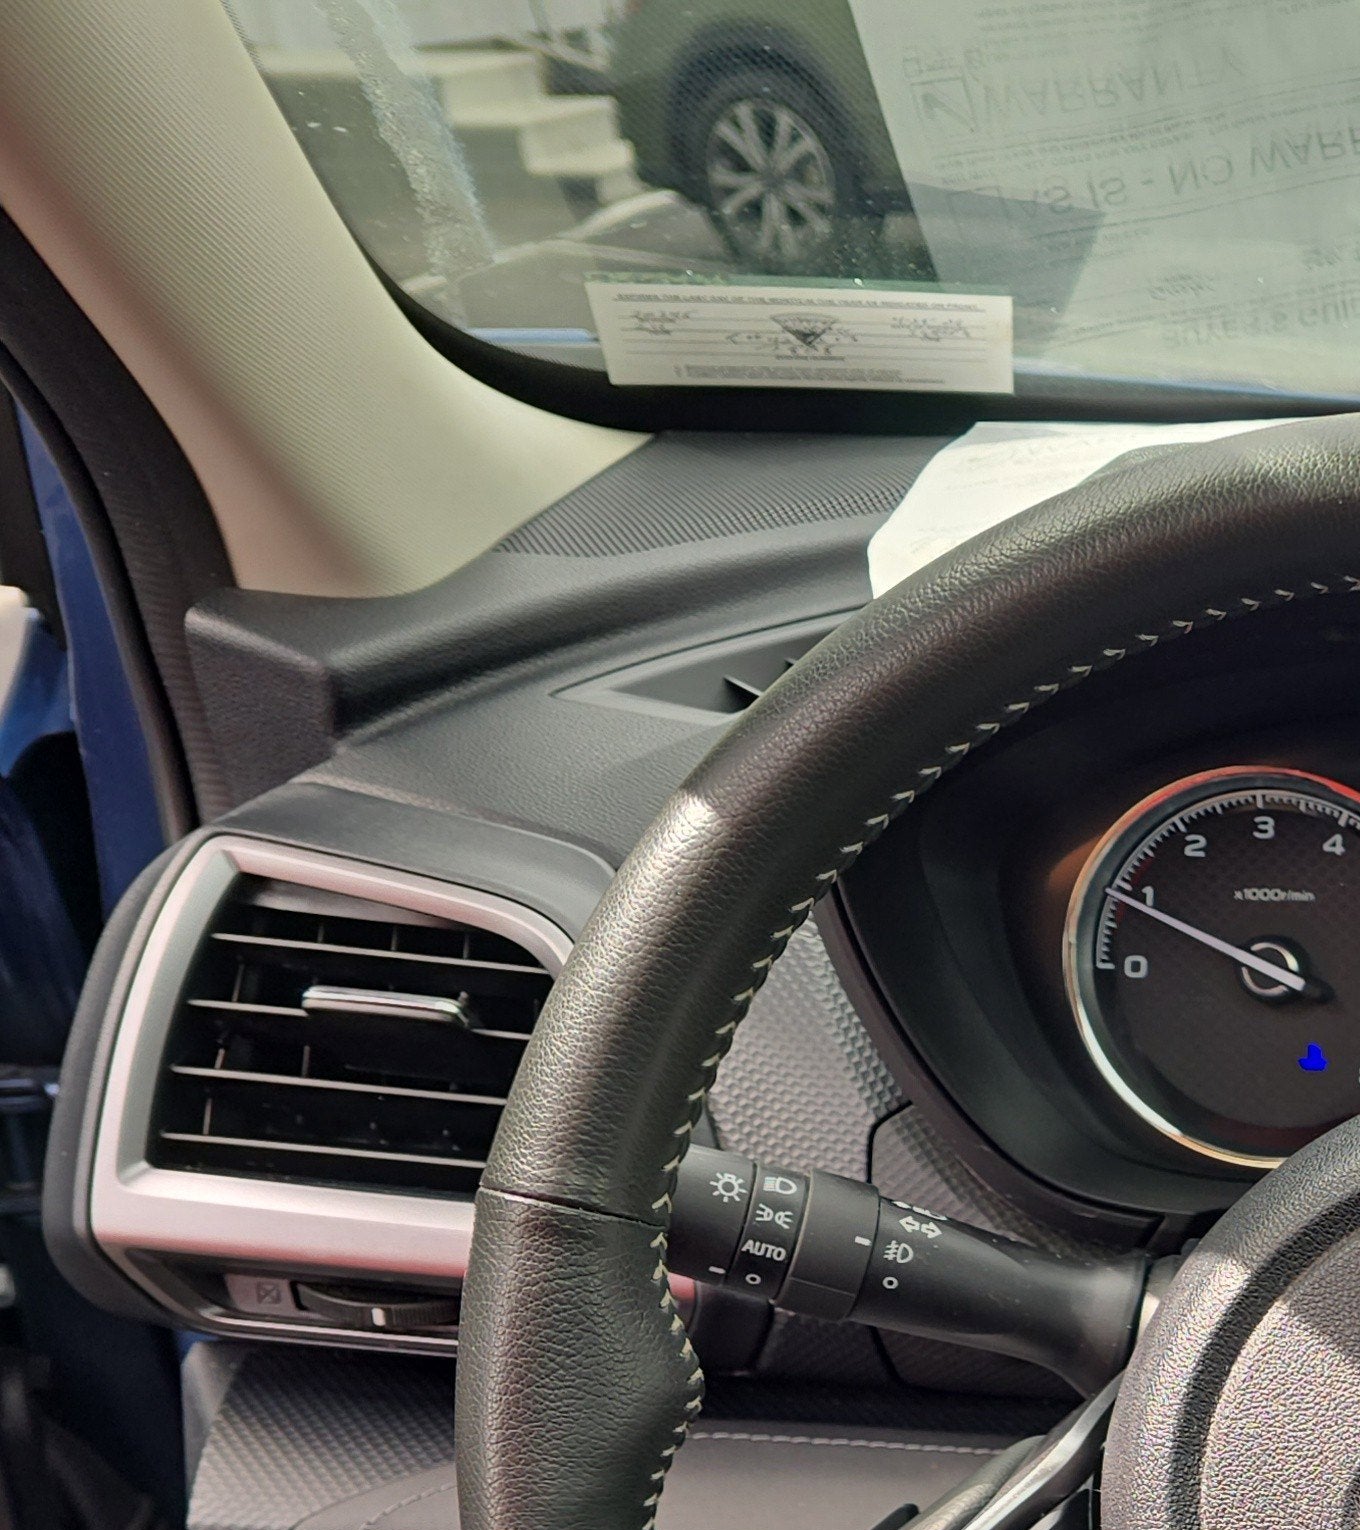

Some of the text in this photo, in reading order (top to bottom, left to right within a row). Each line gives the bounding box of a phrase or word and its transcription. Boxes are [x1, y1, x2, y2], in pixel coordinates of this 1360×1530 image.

[1252, 817, 1276, 840] 3
[1183, 834, 1207, 858] 2
[1322, 833, 1346, 857] 4
[1141, 886, 1155, 908] 1
[1123, 954, 1149, 979] 0
[741, 1238, 787, 1262] AUTO
